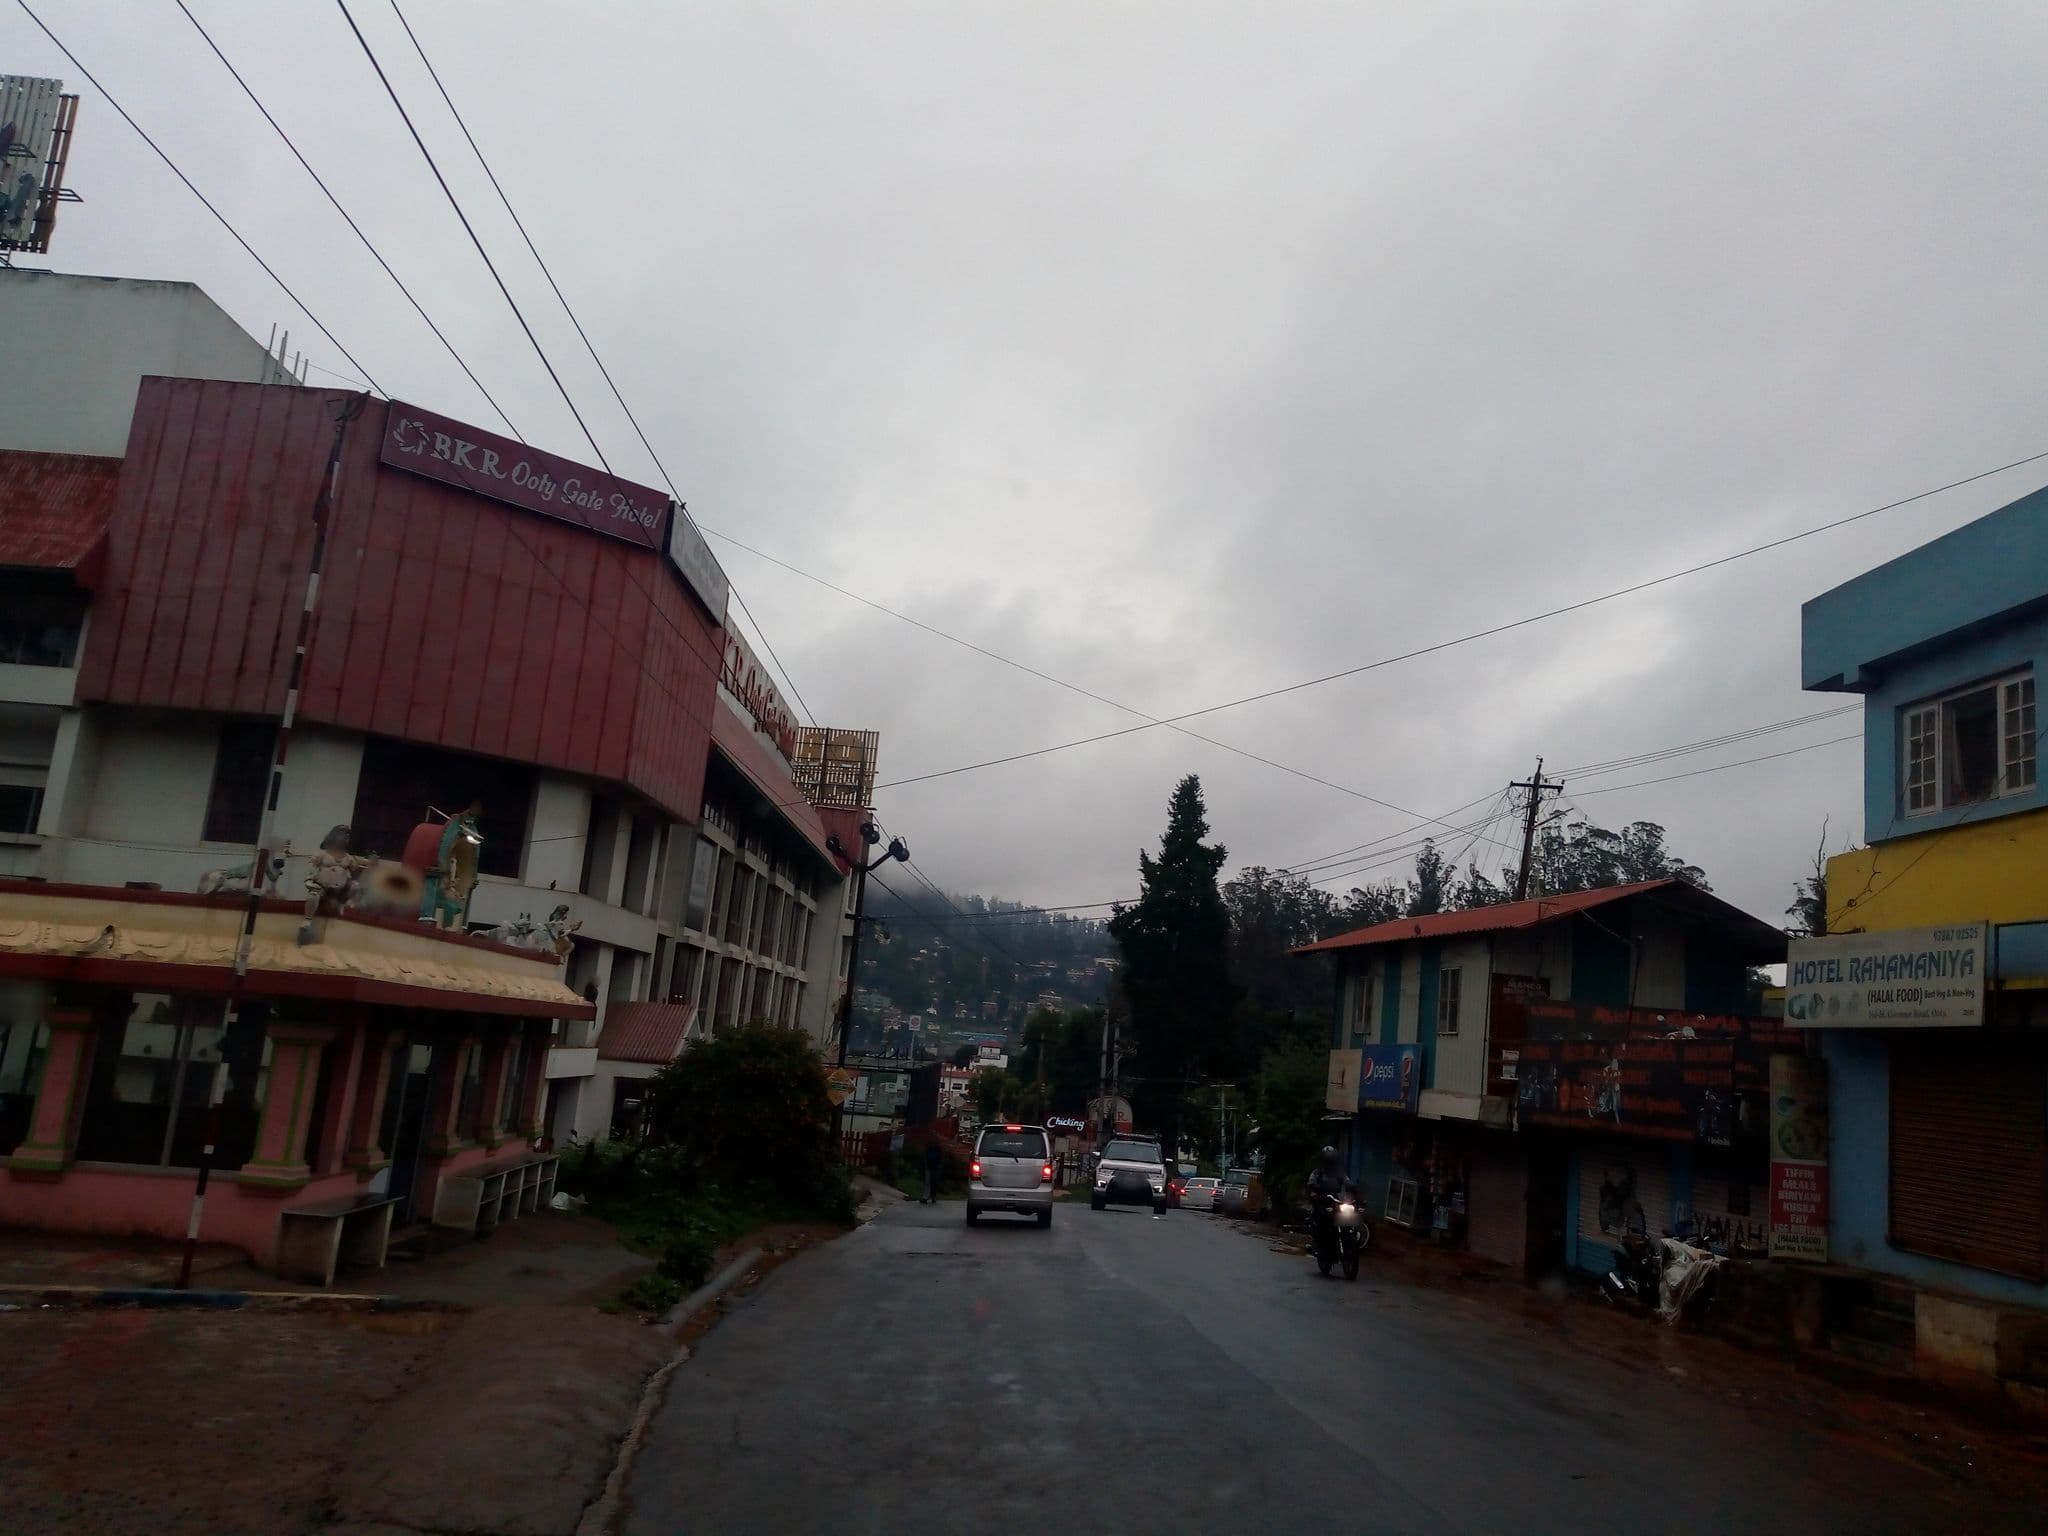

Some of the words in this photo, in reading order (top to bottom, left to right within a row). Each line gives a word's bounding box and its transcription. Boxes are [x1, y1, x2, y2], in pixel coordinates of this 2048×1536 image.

[432, 431, 507, 480] BKR
[511, 461, 558, 502] Ooty
[561, 478, 604, 512] Gate
[609, 493, 662, 530] Hotel
[1793, 958, 1844, 986] HOTEL
[1848, 948, 1976, 984] RAHAMANIYA
[1867, 989, 1894, 1006] (HALAL
[1896, 987, 1923, 1005] FOOD)
[1374, 1062, 1394, 1082] pepsi
[1046, 1116, 1085, 1131] Chicking
[1784, 1168, 1815, 1179] TIFFIN
[1782, 1179, 1817, 1191] MEALS
[1790, 1214, 1808, 1224] FRY
